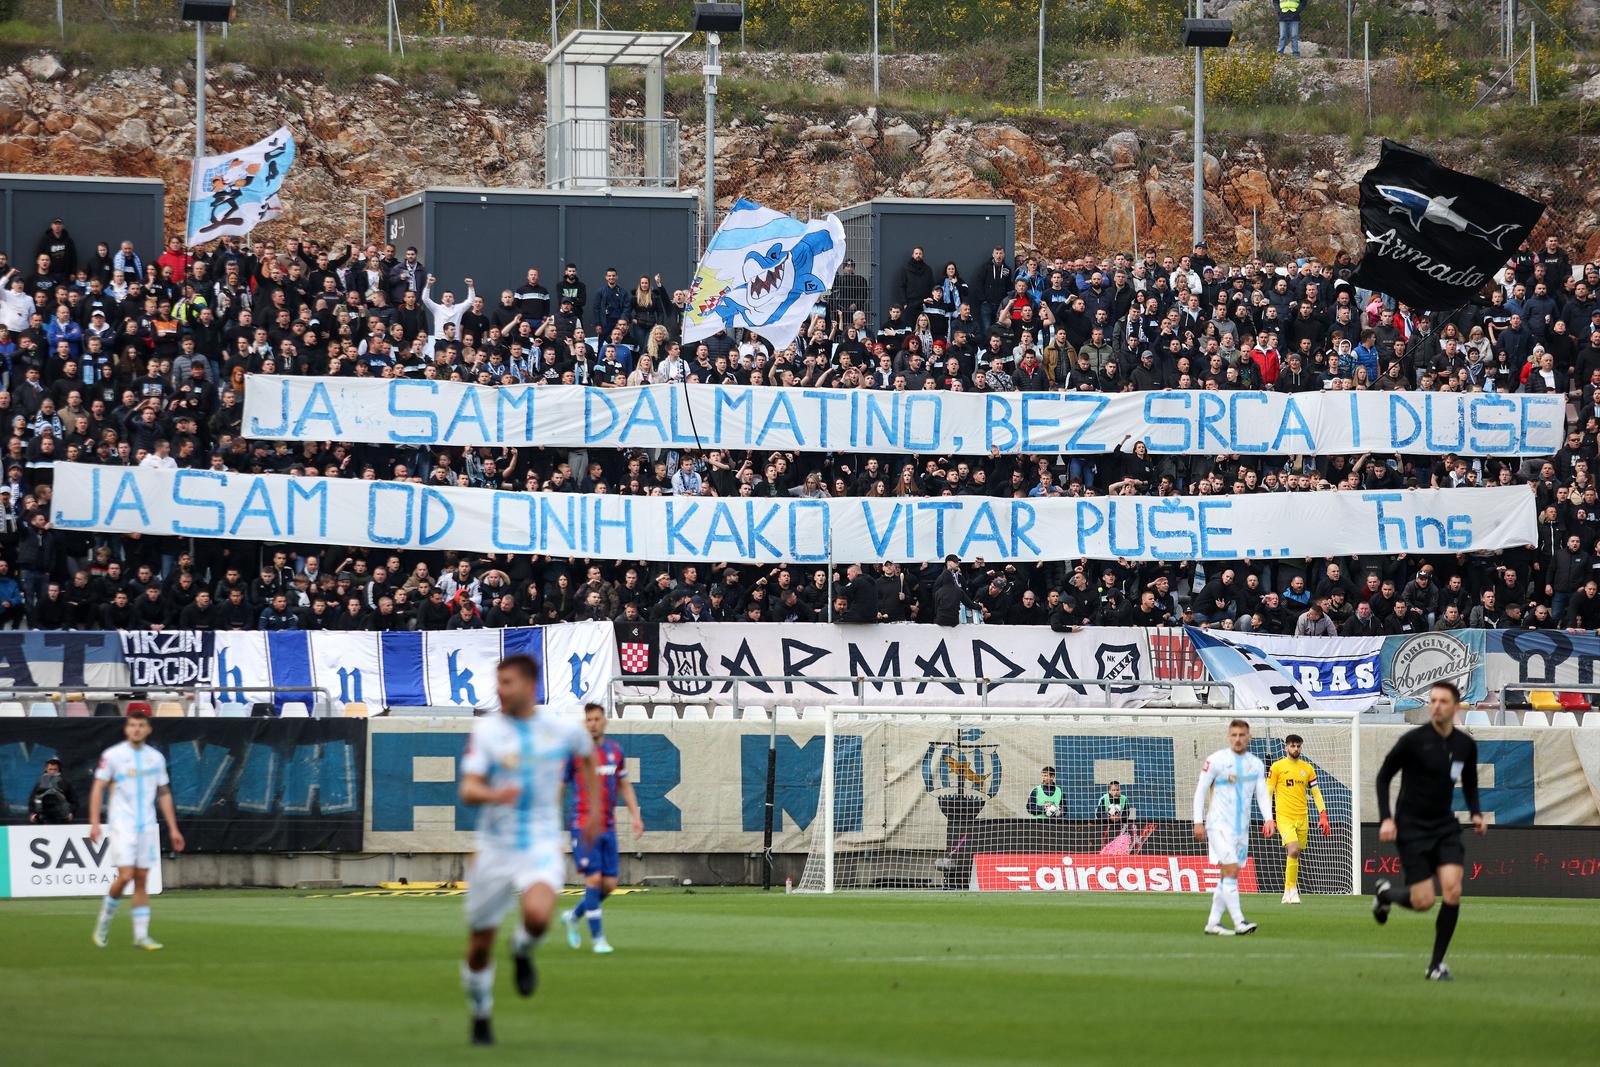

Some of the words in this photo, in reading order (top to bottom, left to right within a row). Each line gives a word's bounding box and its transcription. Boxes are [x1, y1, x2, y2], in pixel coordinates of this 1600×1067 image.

[1366, 228, 1484, 288] Armada
[252, 379, 343, 438] JA
[388, 379, 536, 444] SAM
[583, 385, 964, 452] DALMATINO,
[986, 393, 1111, 453] BEZ
[1143, 391, 1317, 454] SRCA
[1350, 392, 1361, 448] I
[56, 468, 151, 528] JA
[171, 469, 328, 538] SAM
[367, 482, 456, 546] OD
[491, 491, 634, 555] ONIH
[665, 499, 831, 562] KAKO
[861, 500, 1042, 560] VITAR
[719, 636, 1088, 696] ARMADA
[1283, 661, 1376, 693] RAS
[1382, 643, 1481, 690] Armada
[1403, 639, 1457, 662] ORIGINAL
[1035, 856, 1201, 893] aircash
